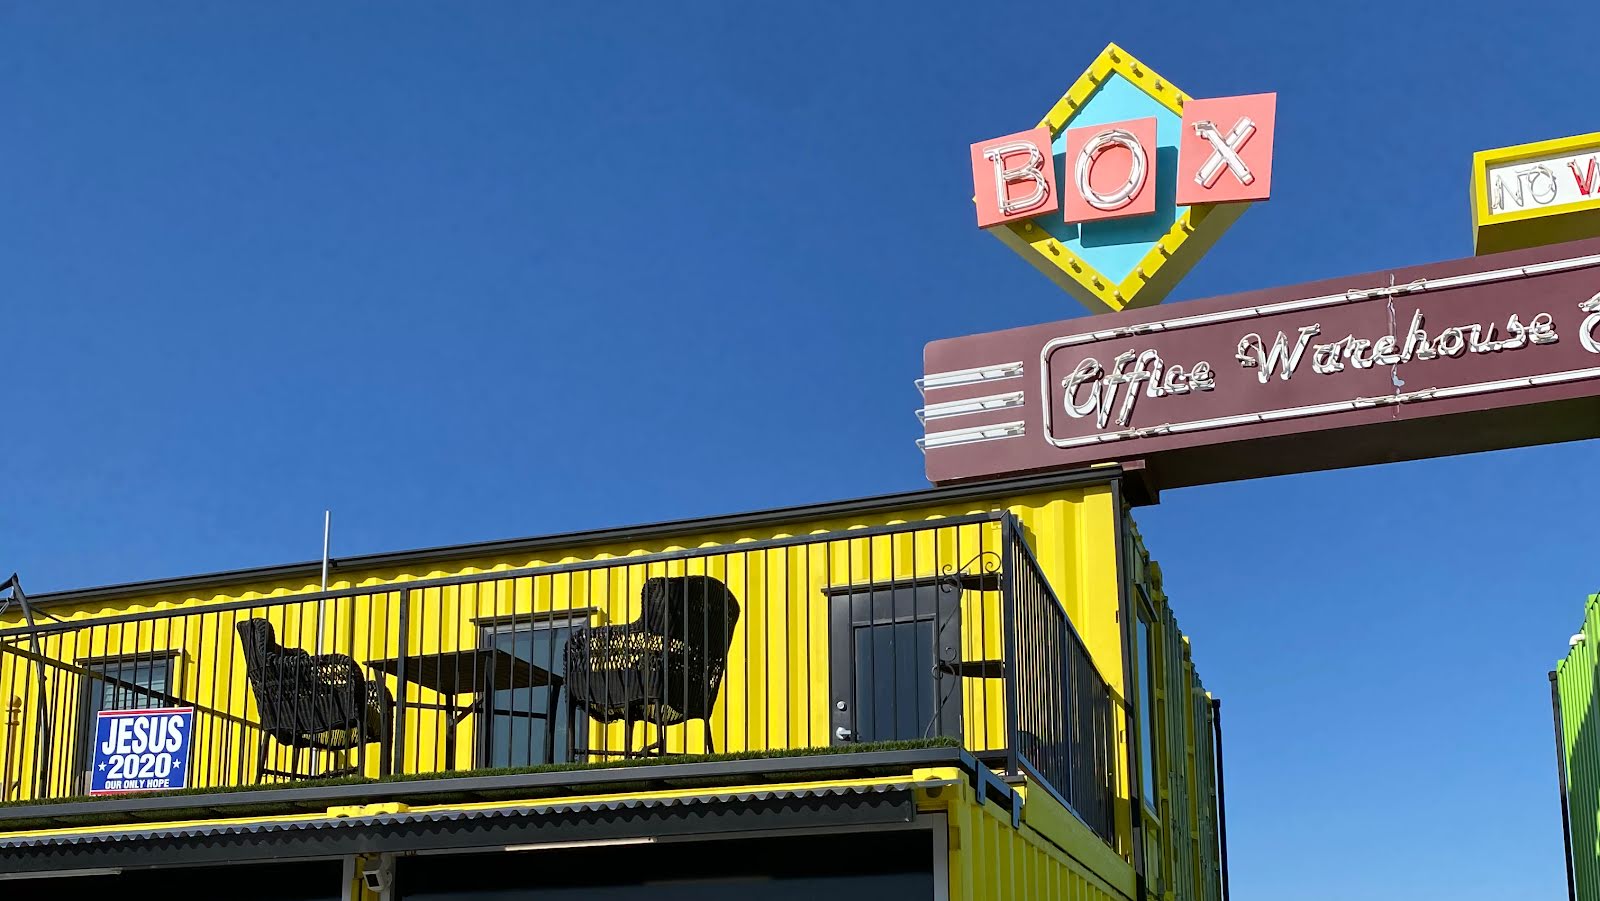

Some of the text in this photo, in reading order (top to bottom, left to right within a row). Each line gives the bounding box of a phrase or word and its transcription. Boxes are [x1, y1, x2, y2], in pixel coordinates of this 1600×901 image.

[983, 116, 1255, 215] BOX
[1490, 163, 1557, 210] NO
[1061, 348, 1216, 428] Office
[1234, 308, 1560, 384] Warehouse
[102, 715, 184, 755] JESUS
[105, 778, 170, 790] OUR ONLY HOPE
[106, 753, 172, 779] 2020
